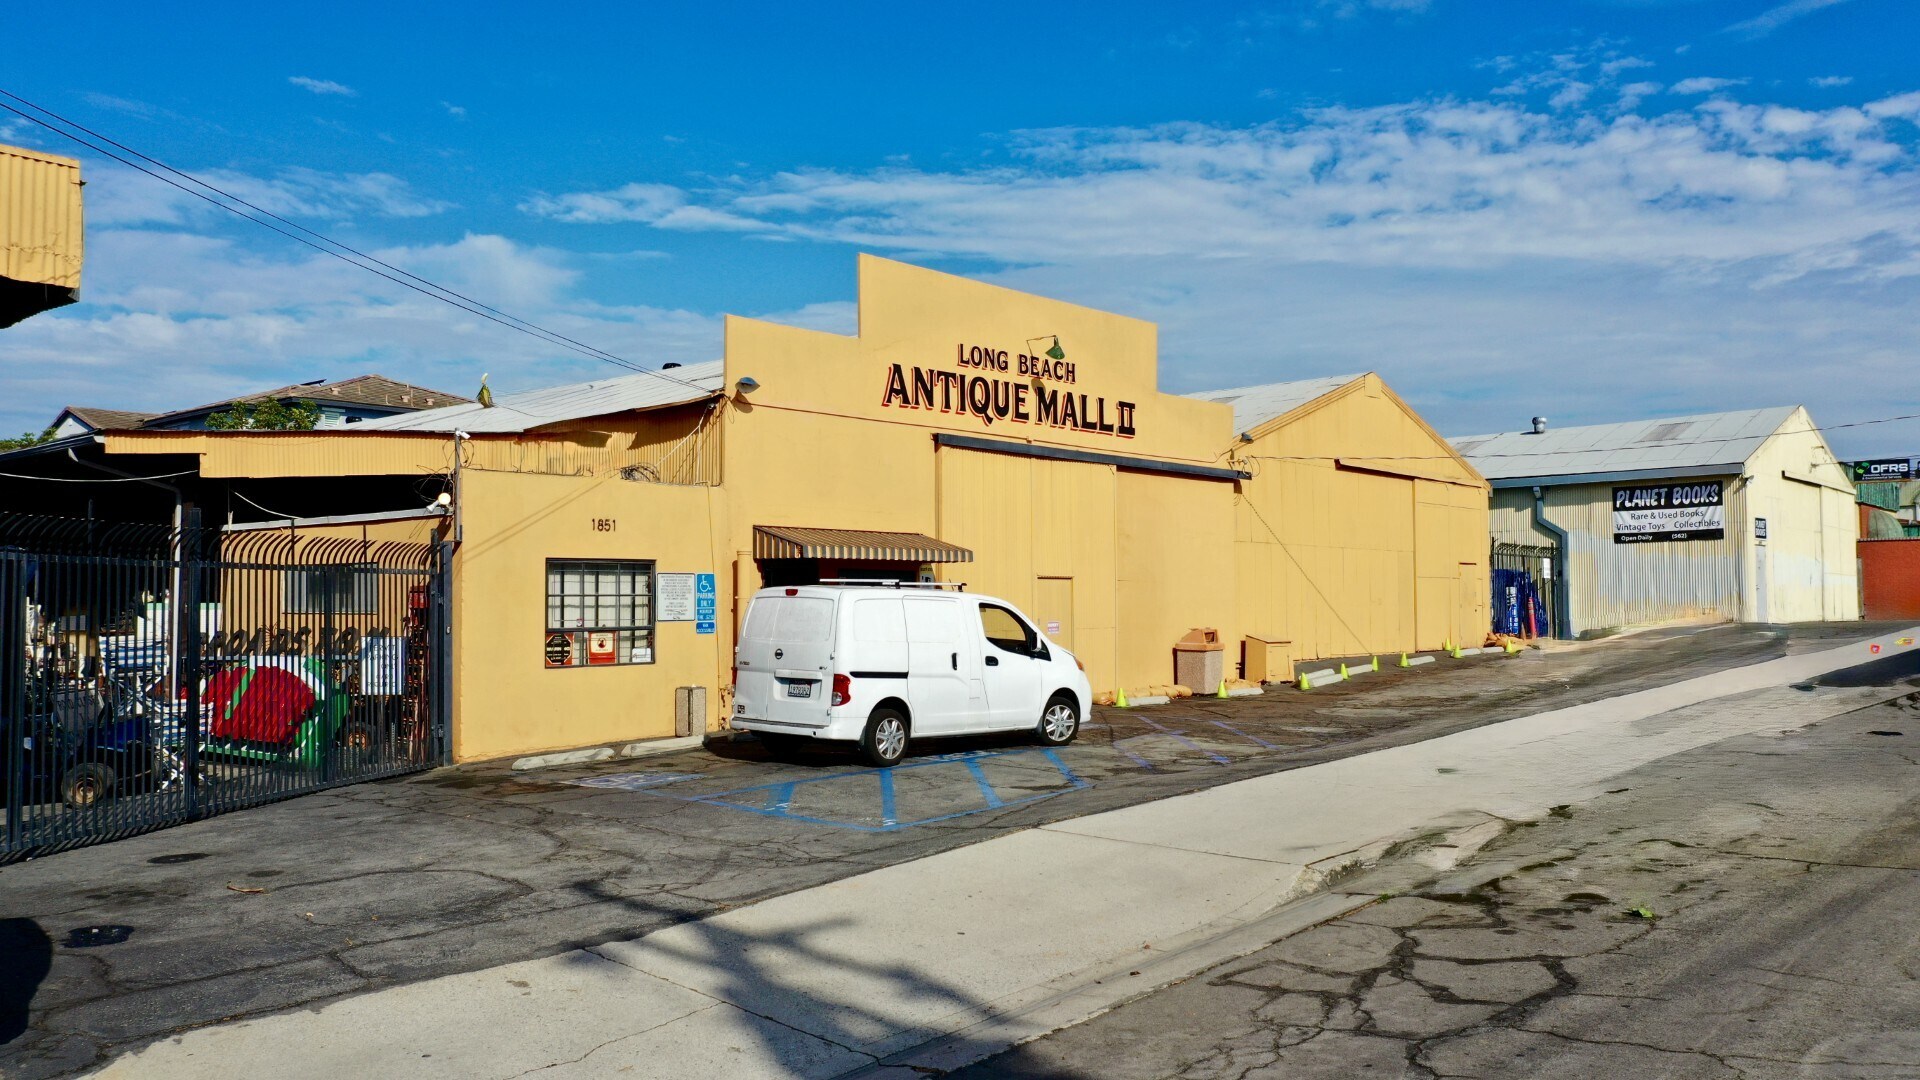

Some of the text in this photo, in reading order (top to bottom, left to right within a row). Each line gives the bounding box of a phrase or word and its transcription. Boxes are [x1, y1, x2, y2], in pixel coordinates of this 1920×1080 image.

[957, 343, 1076, 383] LONG BEACH
[881, 363, 1136, 439] ANTIQUE MALL II
[1871, 463, 1908, 473] OFRS
[1616, 484, 1719, 508] PLANET BOOKS
[1630, 512, 1649, 521] Rare
[1658, 511, 1677, 519] Used
[1680, 509, 1704, 518] Books
[592, 518, 616, 532] 1851
[1616, 522, 1665, 532] Vintage Toys
[1674, 519, 1720, 529] Collectibles
